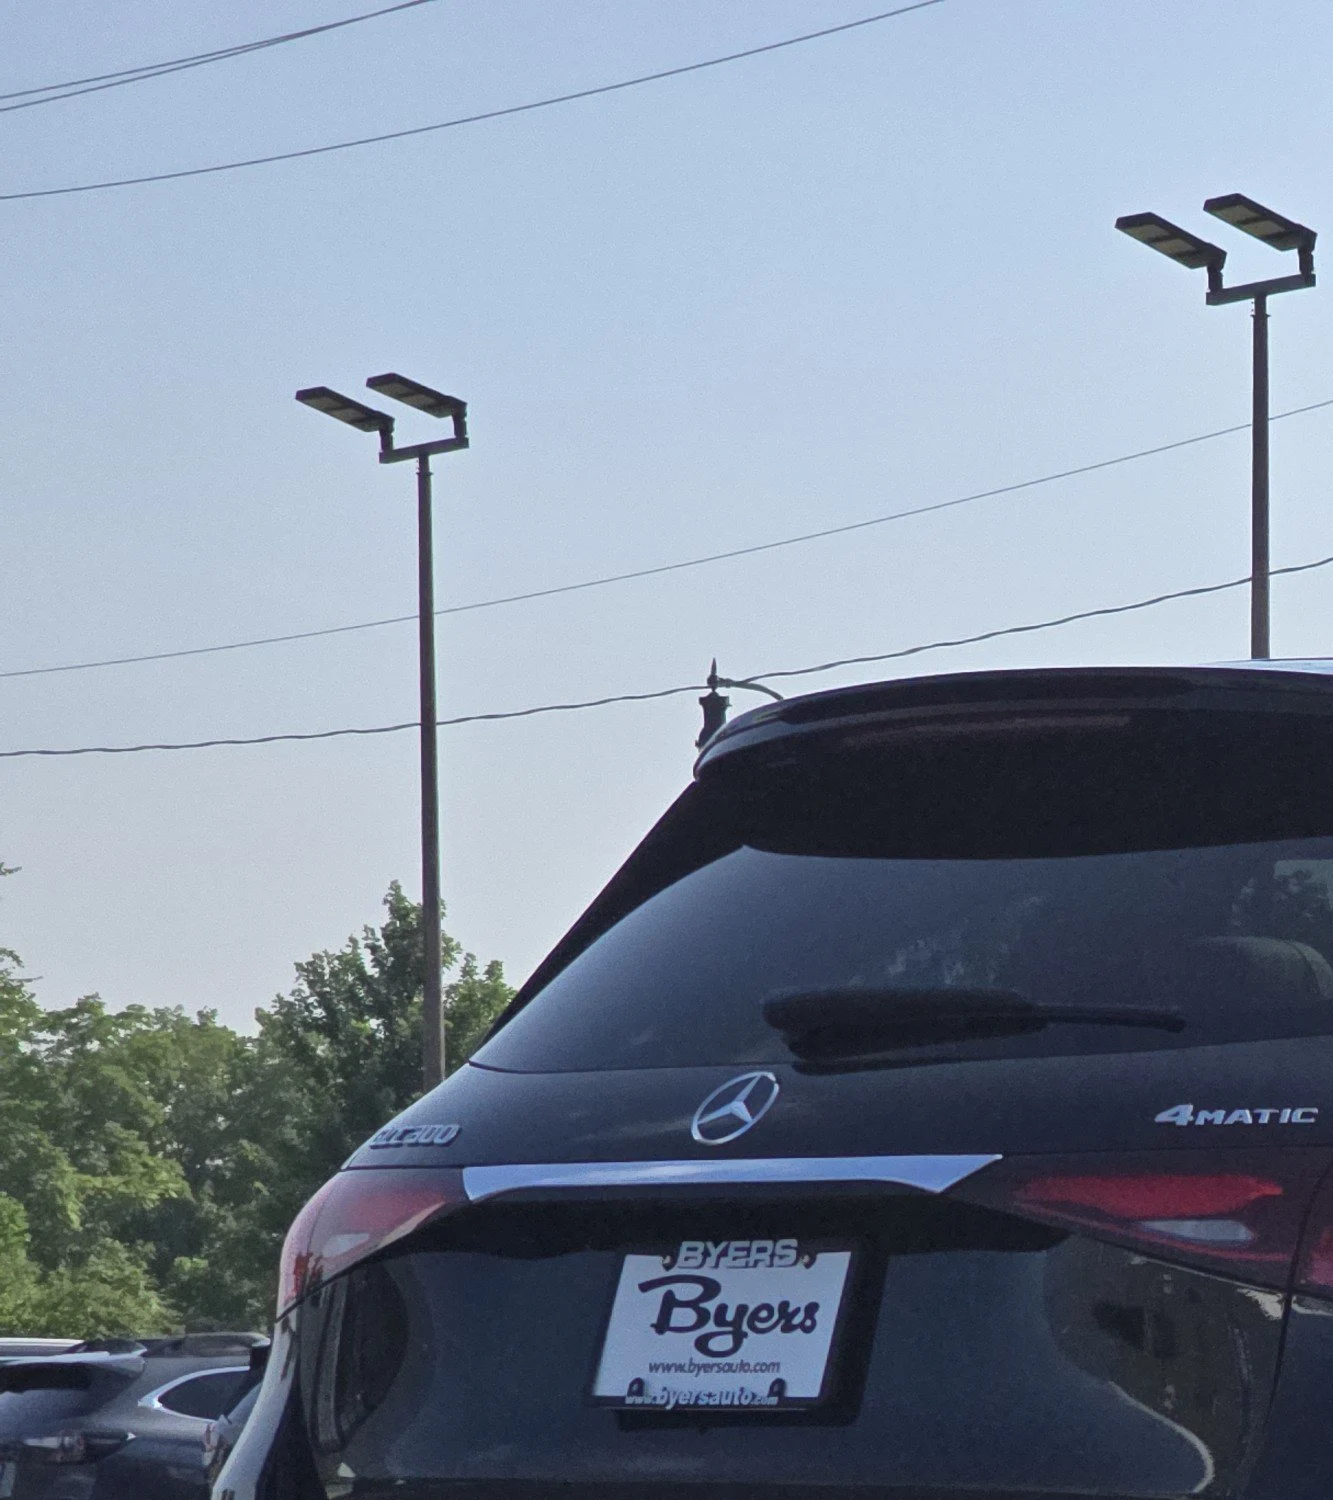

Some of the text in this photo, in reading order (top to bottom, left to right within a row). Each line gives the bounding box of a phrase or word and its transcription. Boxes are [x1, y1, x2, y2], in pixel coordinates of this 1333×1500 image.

[1154, 1103, 1319, 1126] 4MATIC
[677, 1240, 798, 1268] BYERS
[638, 1274, 820, 1358] Byers
[649, 1358, 780, 1377] www.byersauto.com
